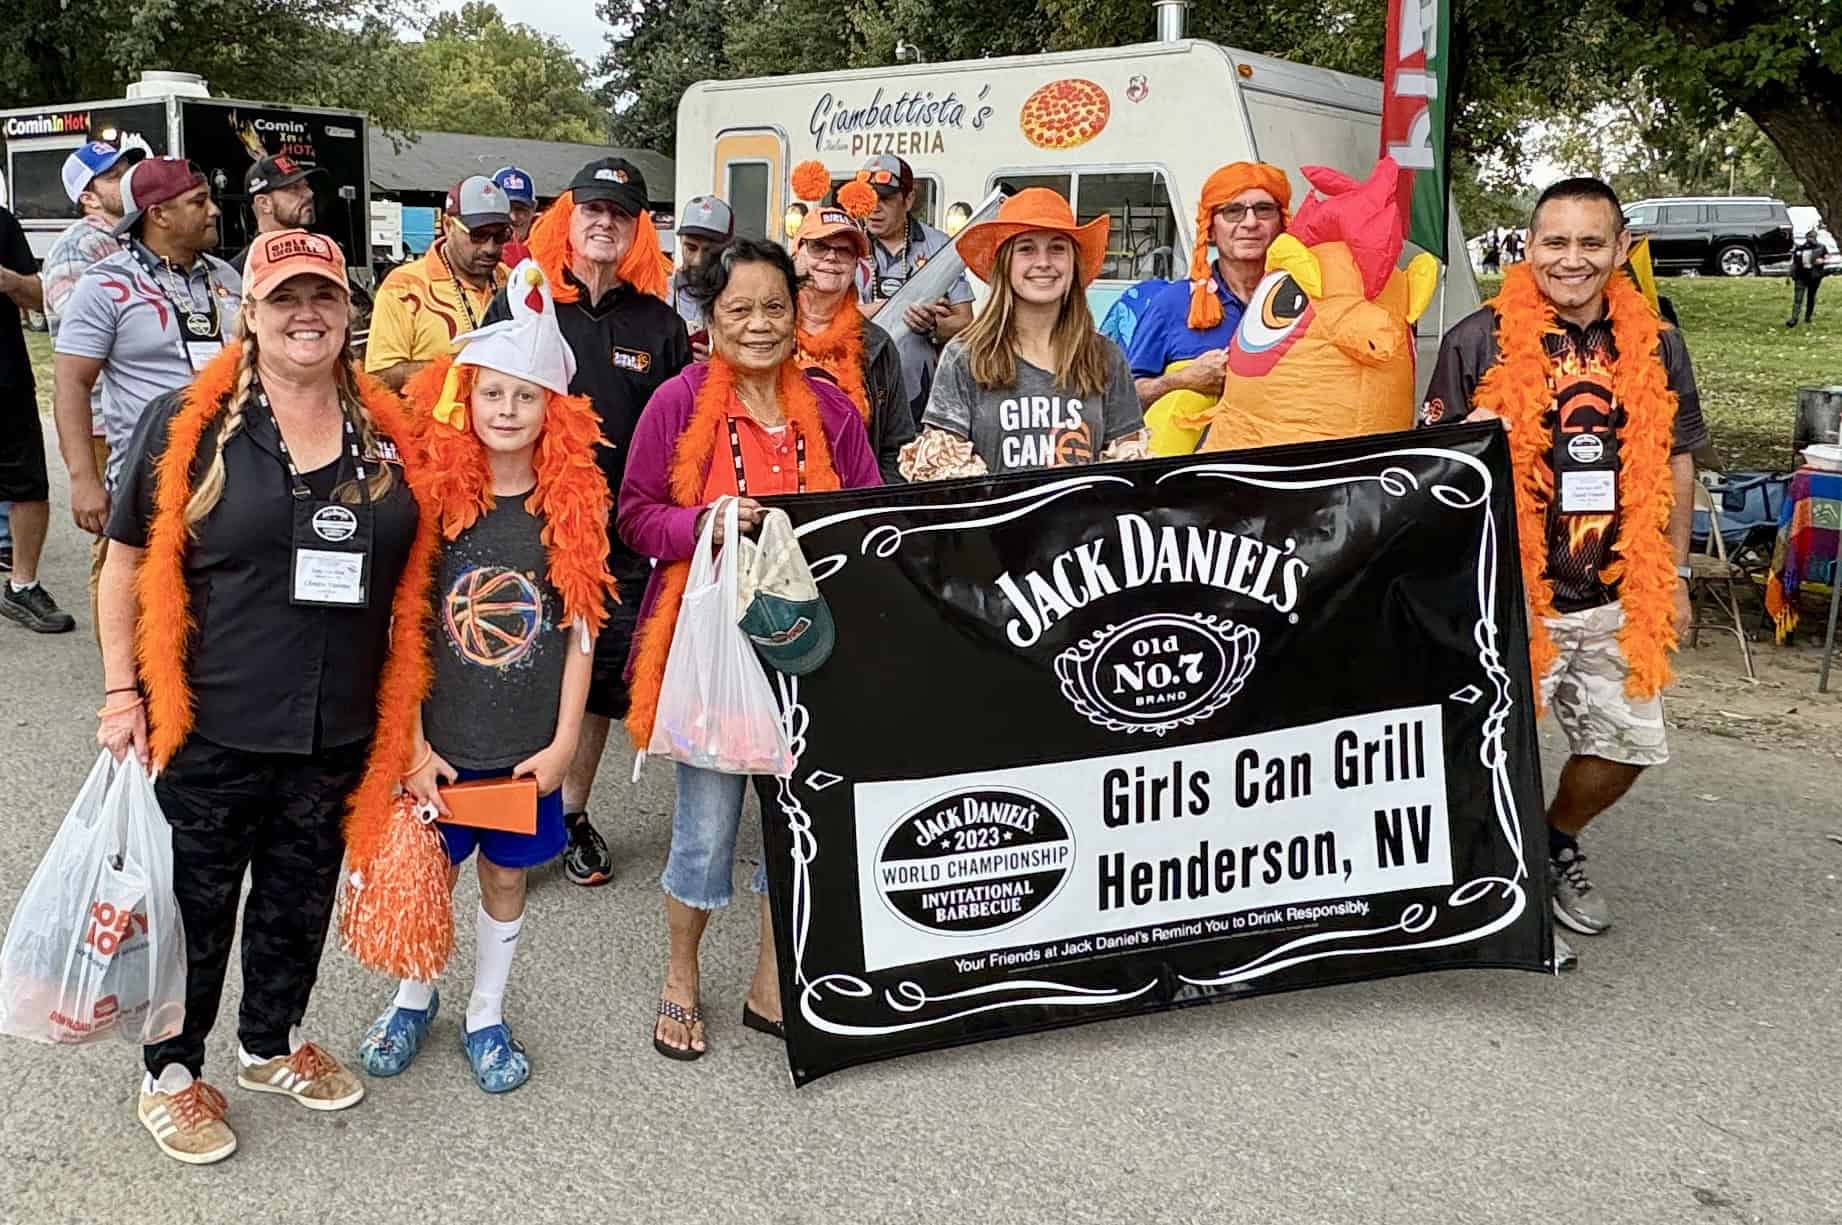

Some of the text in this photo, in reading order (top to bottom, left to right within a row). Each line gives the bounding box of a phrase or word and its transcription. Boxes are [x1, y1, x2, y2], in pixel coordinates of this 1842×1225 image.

[809, 84, 993, 152] Giambattista's
[851, 130, 945, 156] PIZZERIA
[999, 396, 1083, 431] GIRLS
[1002, 434, 1057, 468] CAN
[994, 512, 1310, 648] JACK DANIEL'S
[1132, 635, 1180, 657] Old
[1135, 690, 1187, 707] BRAND
[1103, 720, 1426, 829] Girls Can Grill
[912, 797, 1040, 847] JACK DANIEL'S
[954, 827, 1000, 851] 2023
[882, 846, 1069, 887] WORLD CHAMPIONSHIP
[1098, 804, 1432, 912] Henderson, NV
[921, 880, 1035, 909] INVITATIONAL
[935, 897, 1022, 923] BARBECUE
[954, 900, 1371, 974] Your Friends at Jack Daniel's Remind You to Drink Responsibly.
